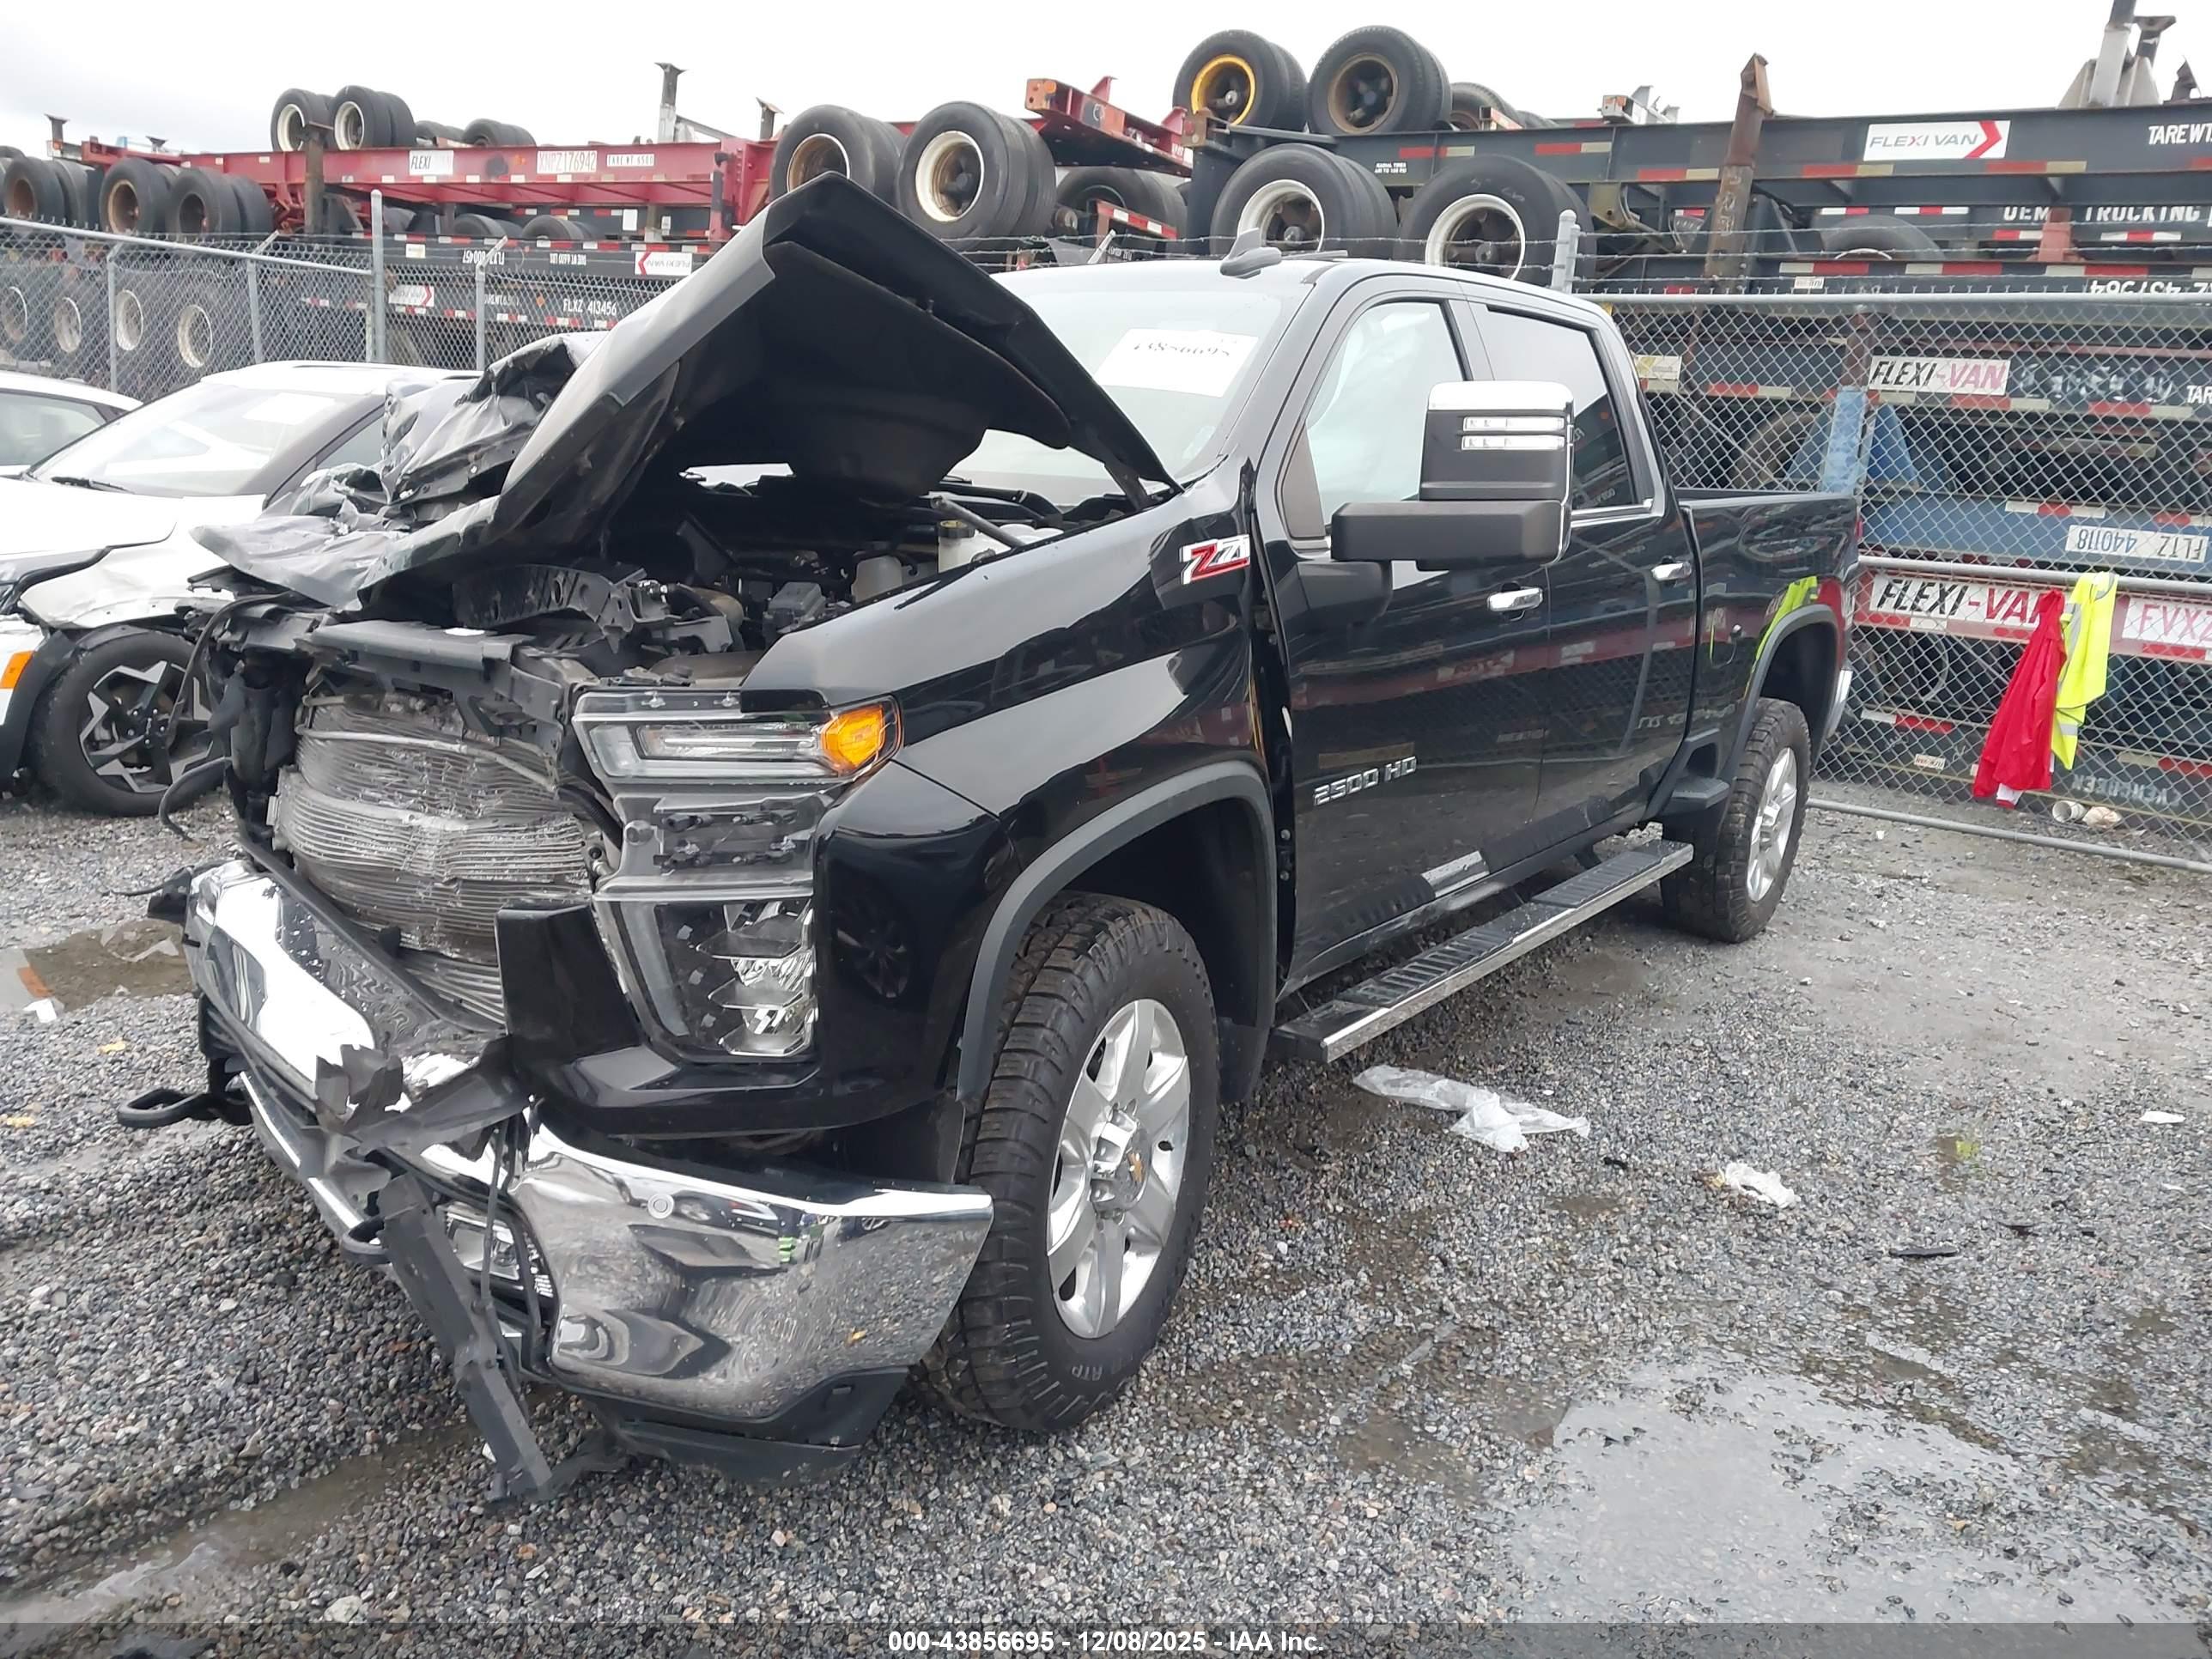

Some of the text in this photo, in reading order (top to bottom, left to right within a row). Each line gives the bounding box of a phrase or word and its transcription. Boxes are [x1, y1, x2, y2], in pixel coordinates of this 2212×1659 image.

[1869, 133, 1979, 148] FLEXI VAN
[2077, 528, 2137, 554] 440118
[1314, 757, 1417, 806] 2500 HD
